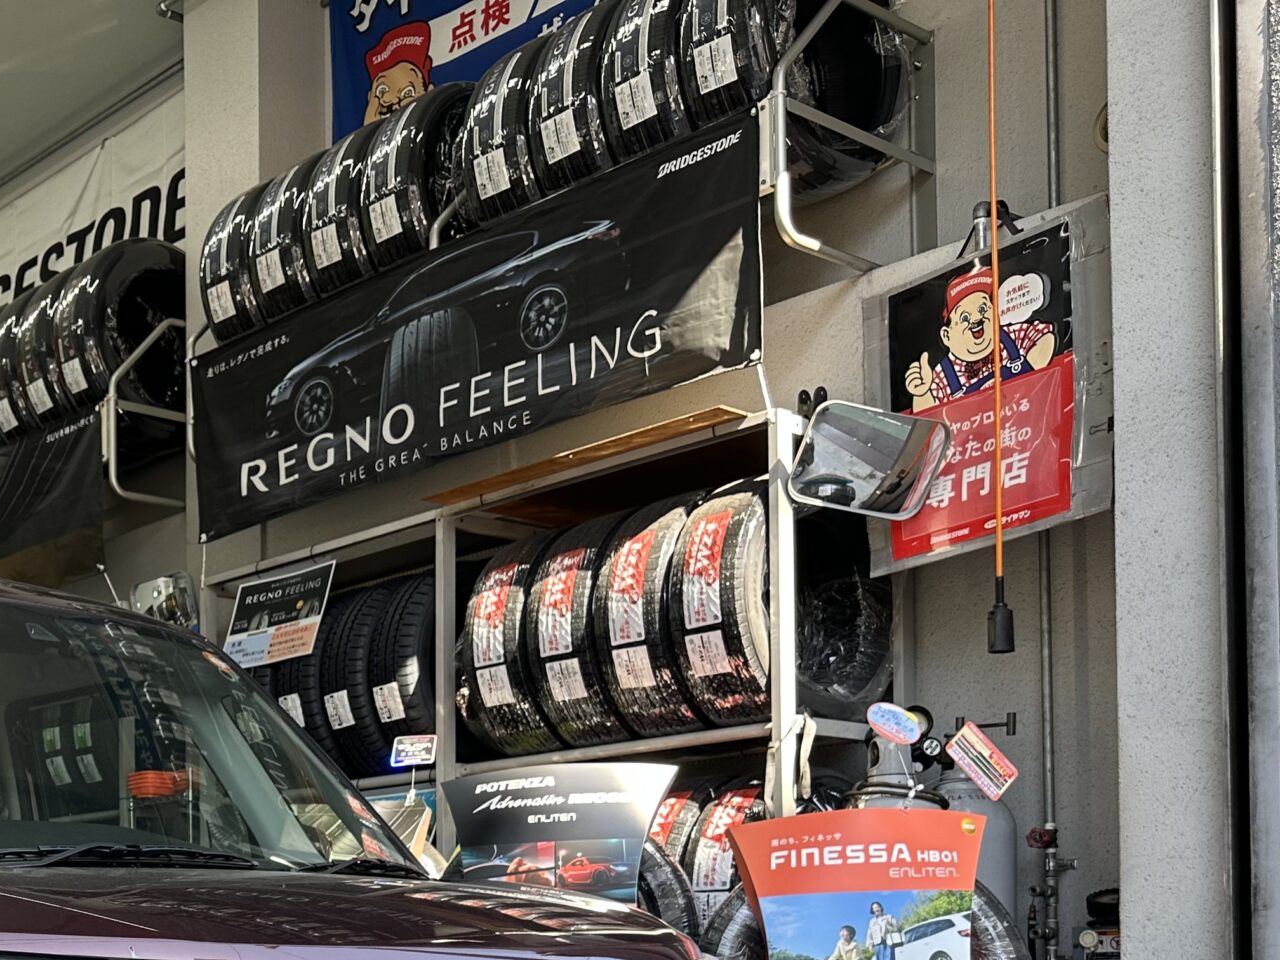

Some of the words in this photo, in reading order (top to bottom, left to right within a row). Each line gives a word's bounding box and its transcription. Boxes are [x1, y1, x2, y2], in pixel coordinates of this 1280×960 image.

[449, 0, 510, 53] 点検
[657, 129, 742, 179] BRIDGESTONE
[240, 403, 416, 497] REGNO
[438, 310, 663, 428] FEELING
[339, 468, 366, 486] THE
[374, 442, 429, 474] GREA
[440, 410, 533, 452] BALANCE
[926, 451, 1030, 508] 専門店
[245, 590, 282, 605] REGNO
[285, 578, 321, 596] FEELING
[475, 776, 555, 794] POTENZA
[473, 794, 567, 814] Adrenalin
[527, 812, 577, 823] ENLITEN
[771, 832, 842, 847] 雨のち、フィネッサ
[770, 843, 912, 870] FINESSA
[916, 850, 958, 863] HB01
